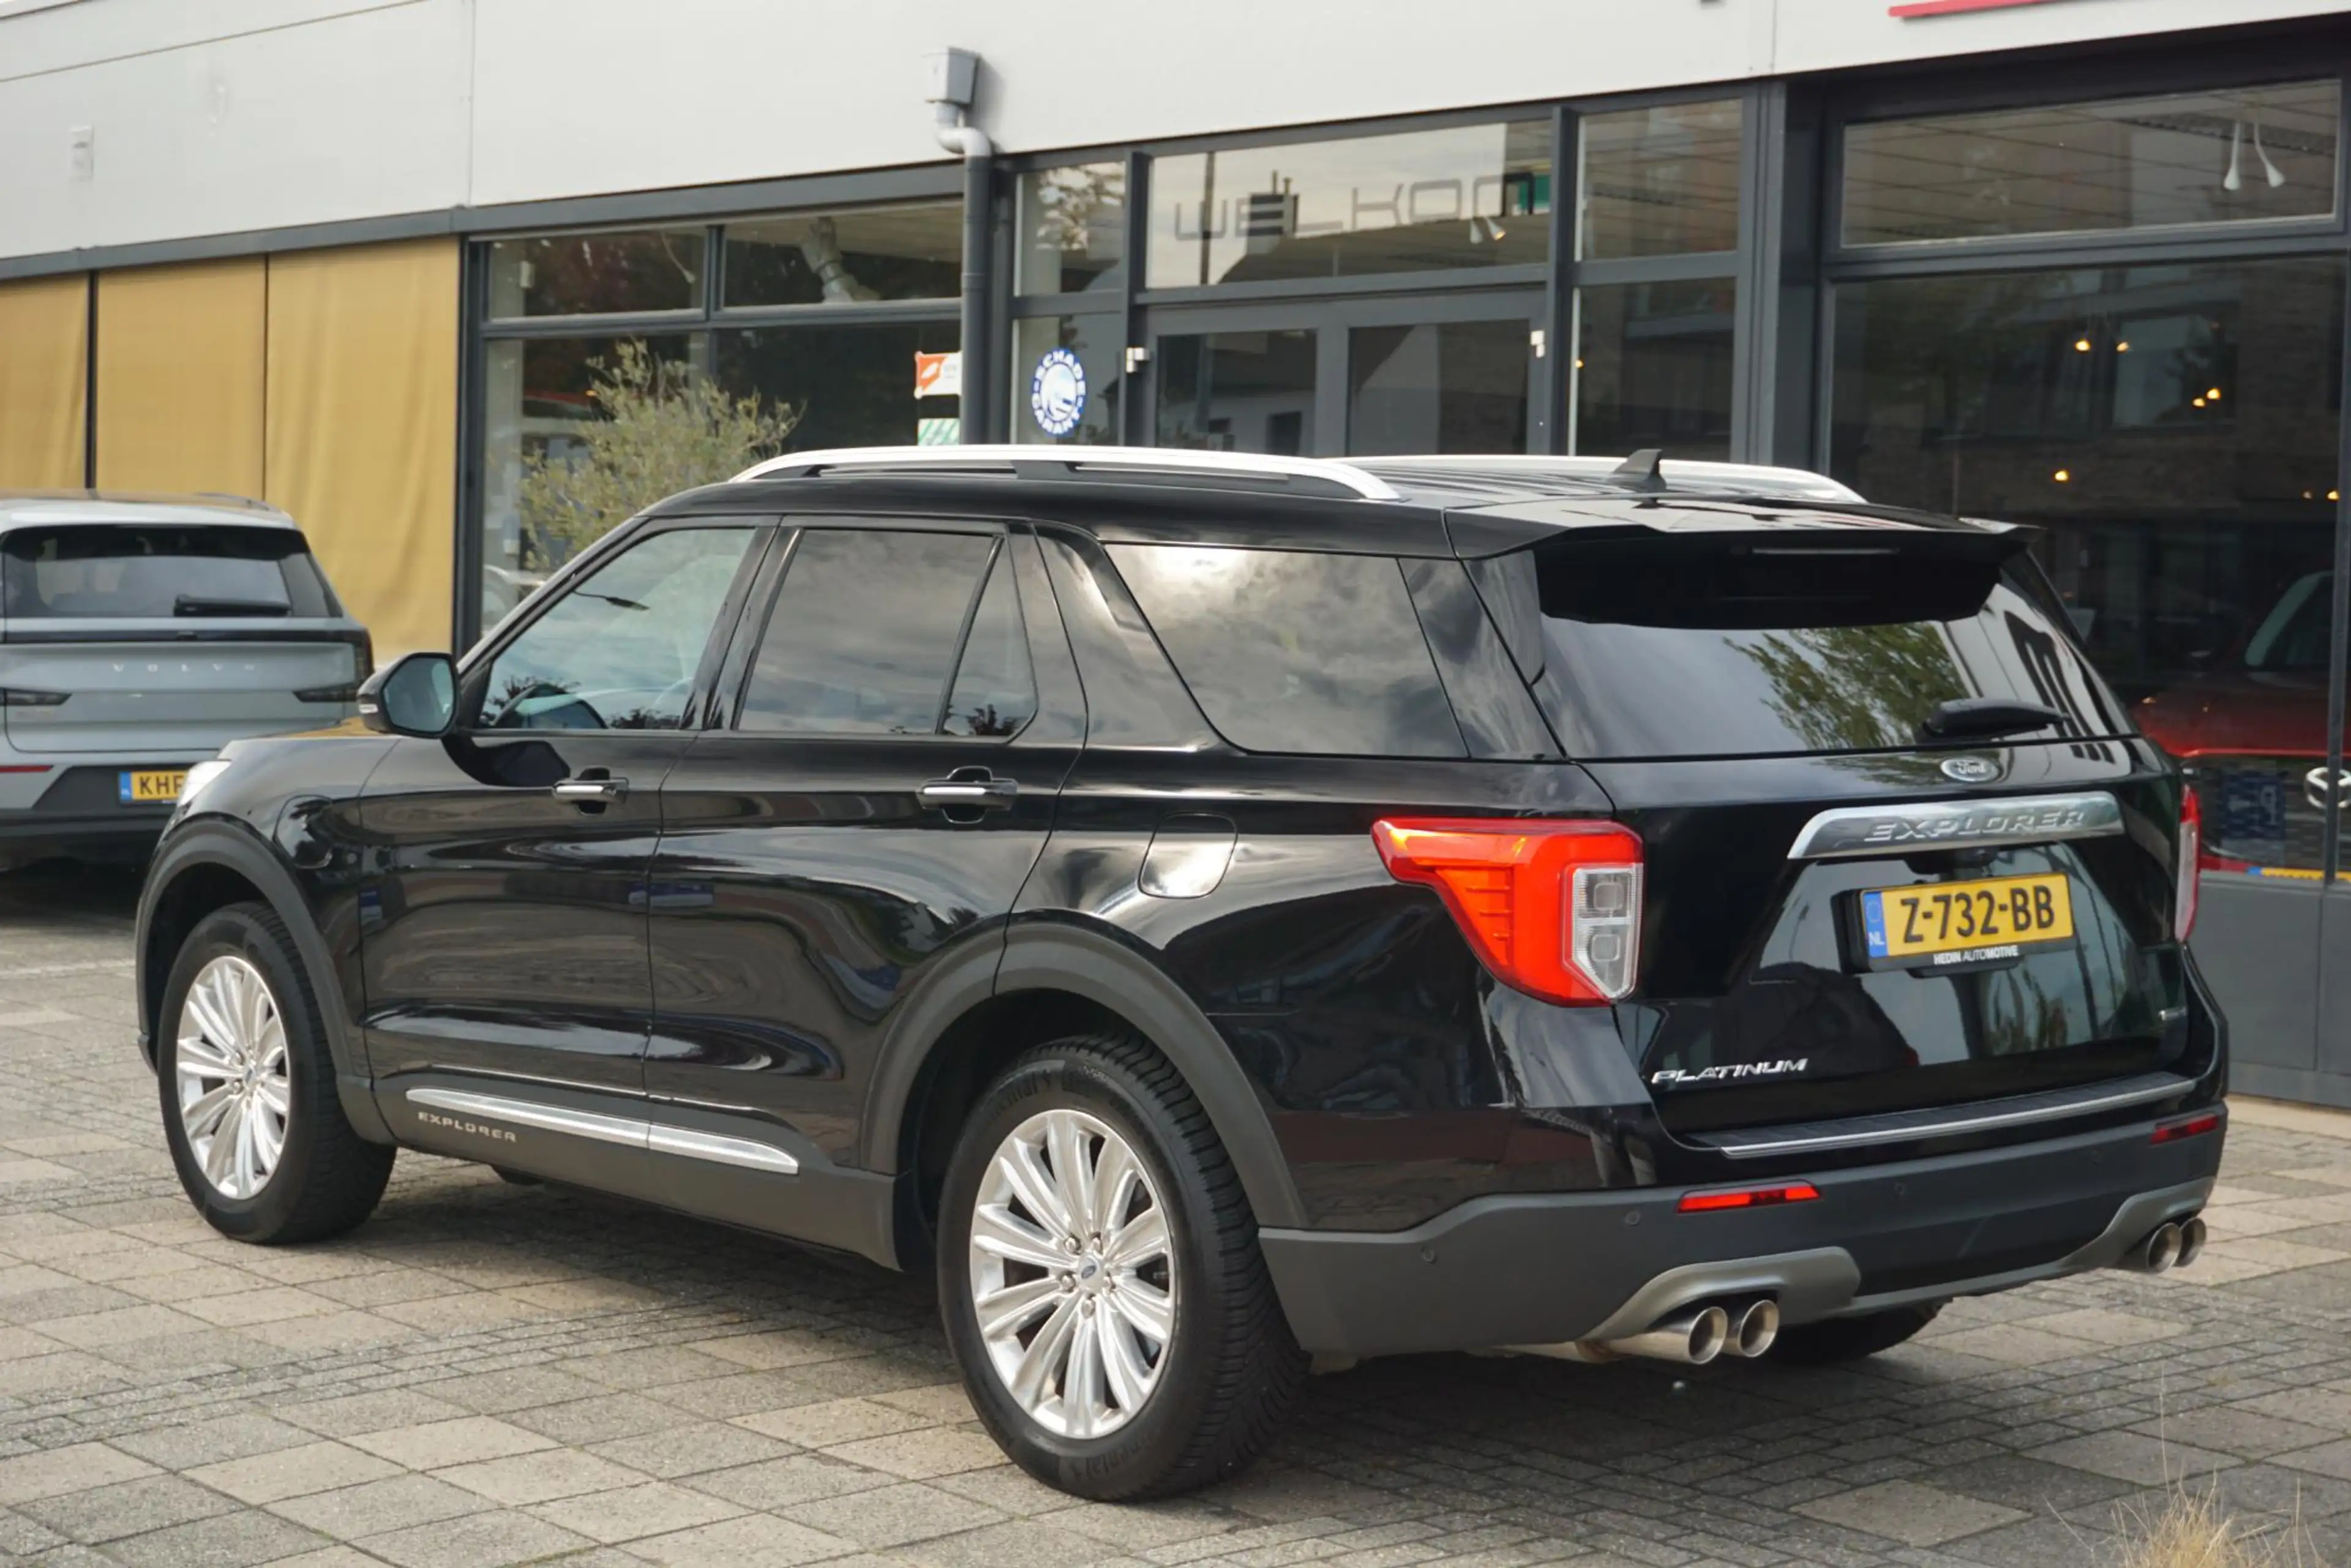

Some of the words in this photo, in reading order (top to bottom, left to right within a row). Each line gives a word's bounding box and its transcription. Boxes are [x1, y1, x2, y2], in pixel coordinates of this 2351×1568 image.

[1175, 171, 1534, 240] WELKOM
[1035, 350, 1086, 396] SCHADE
[1032, 392, 1081, 435] GARANT
[113, 662, 255, 672] VOLVO
[1864, 811, 2085, 842] EXPLORER
[1900, 885, 2055, 943] Z-732-BB
[1869, 931, 1885, 946] NL
[1933, 951, 1961, 965] HEDIN
[1962, 944, 2019, 962] AUTOMOTIVE
[1651, 1058, 1809, 1084] PLATINUM
[418, 1111, 517, 1143] EXPLORER
